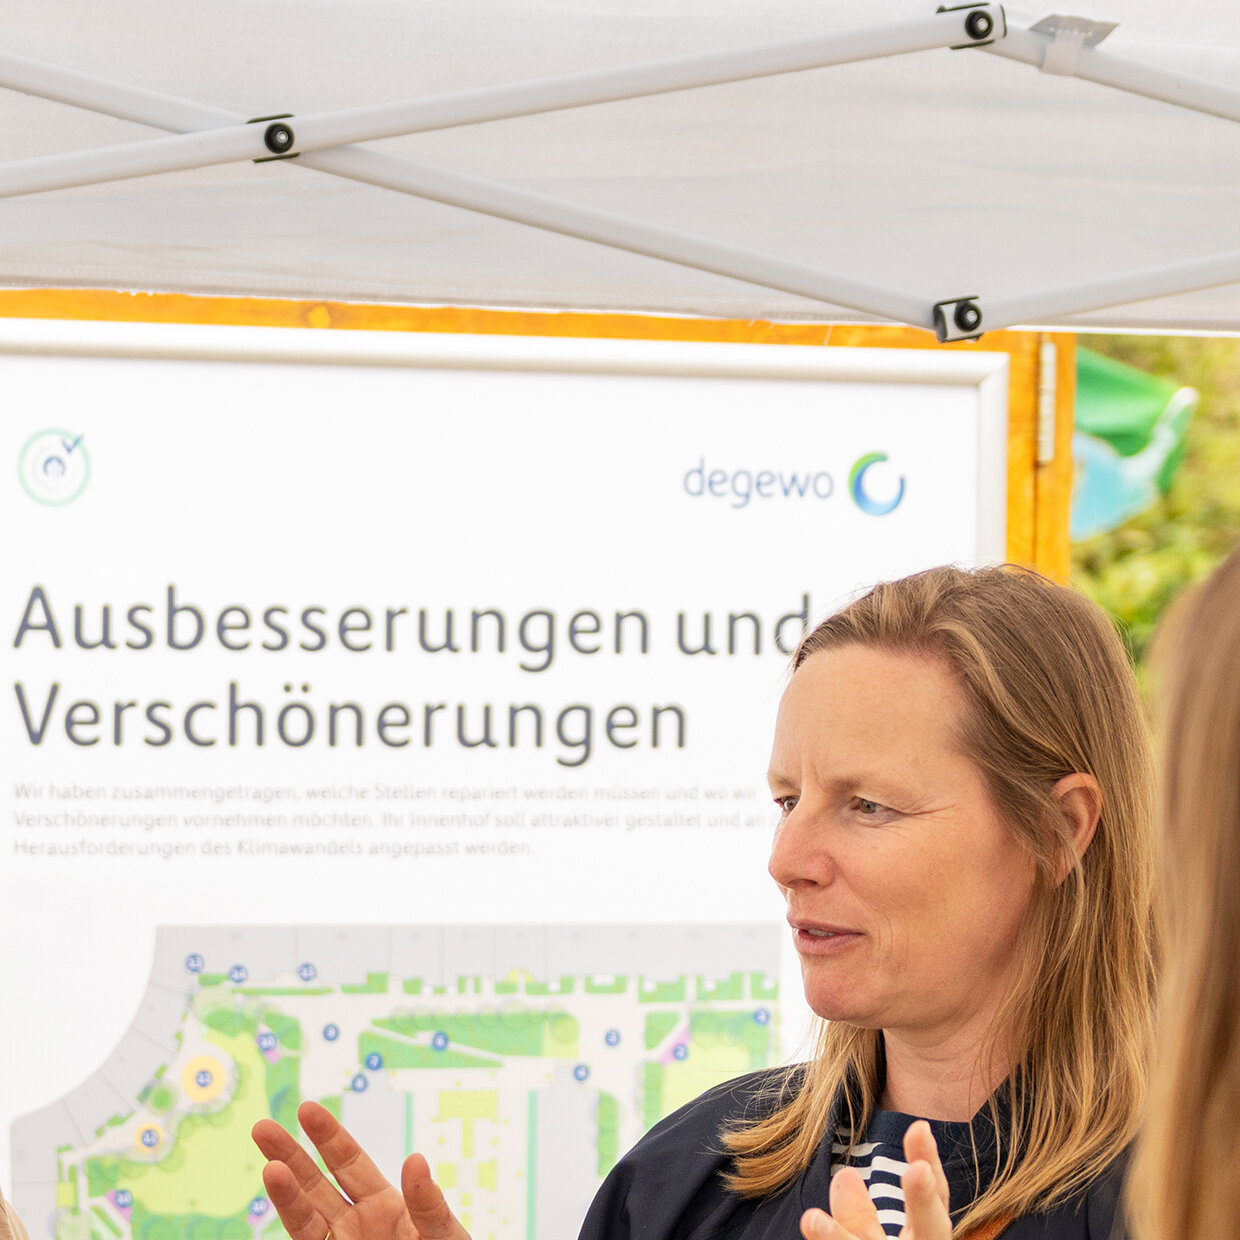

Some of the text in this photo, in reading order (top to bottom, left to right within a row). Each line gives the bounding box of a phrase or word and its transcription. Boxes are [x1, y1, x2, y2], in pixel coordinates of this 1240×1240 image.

[683, 456, 834, 509] degewo
[13, 584, 809, 672] Ausbesserungen und
[14, 680, 686, 767] Verschönerungen
[49, 782, 106, 799] haben
